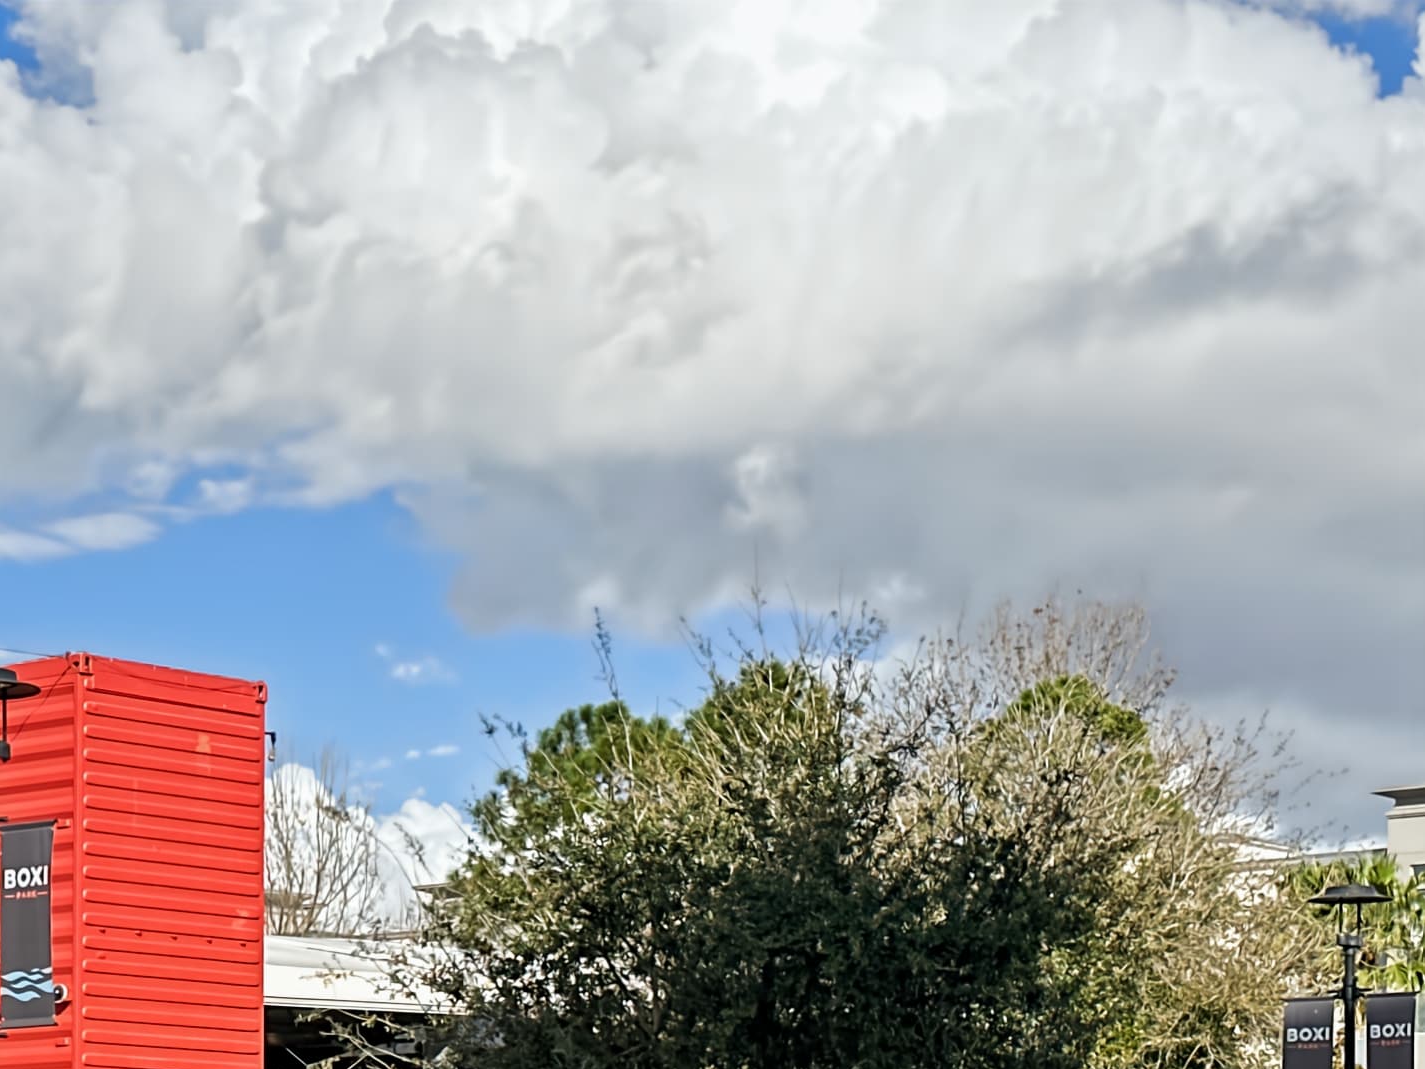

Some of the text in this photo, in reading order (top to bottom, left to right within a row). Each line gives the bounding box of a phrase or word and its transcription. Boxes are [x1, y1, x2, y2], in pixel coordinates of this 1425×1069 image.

[4, 865, 49, 890] BOXI
[16, 891, 37, 900] PARK
[1287, 1027, 1330, 1042] BOXI
[1370, 1022, 1411, 1039] BOXI
